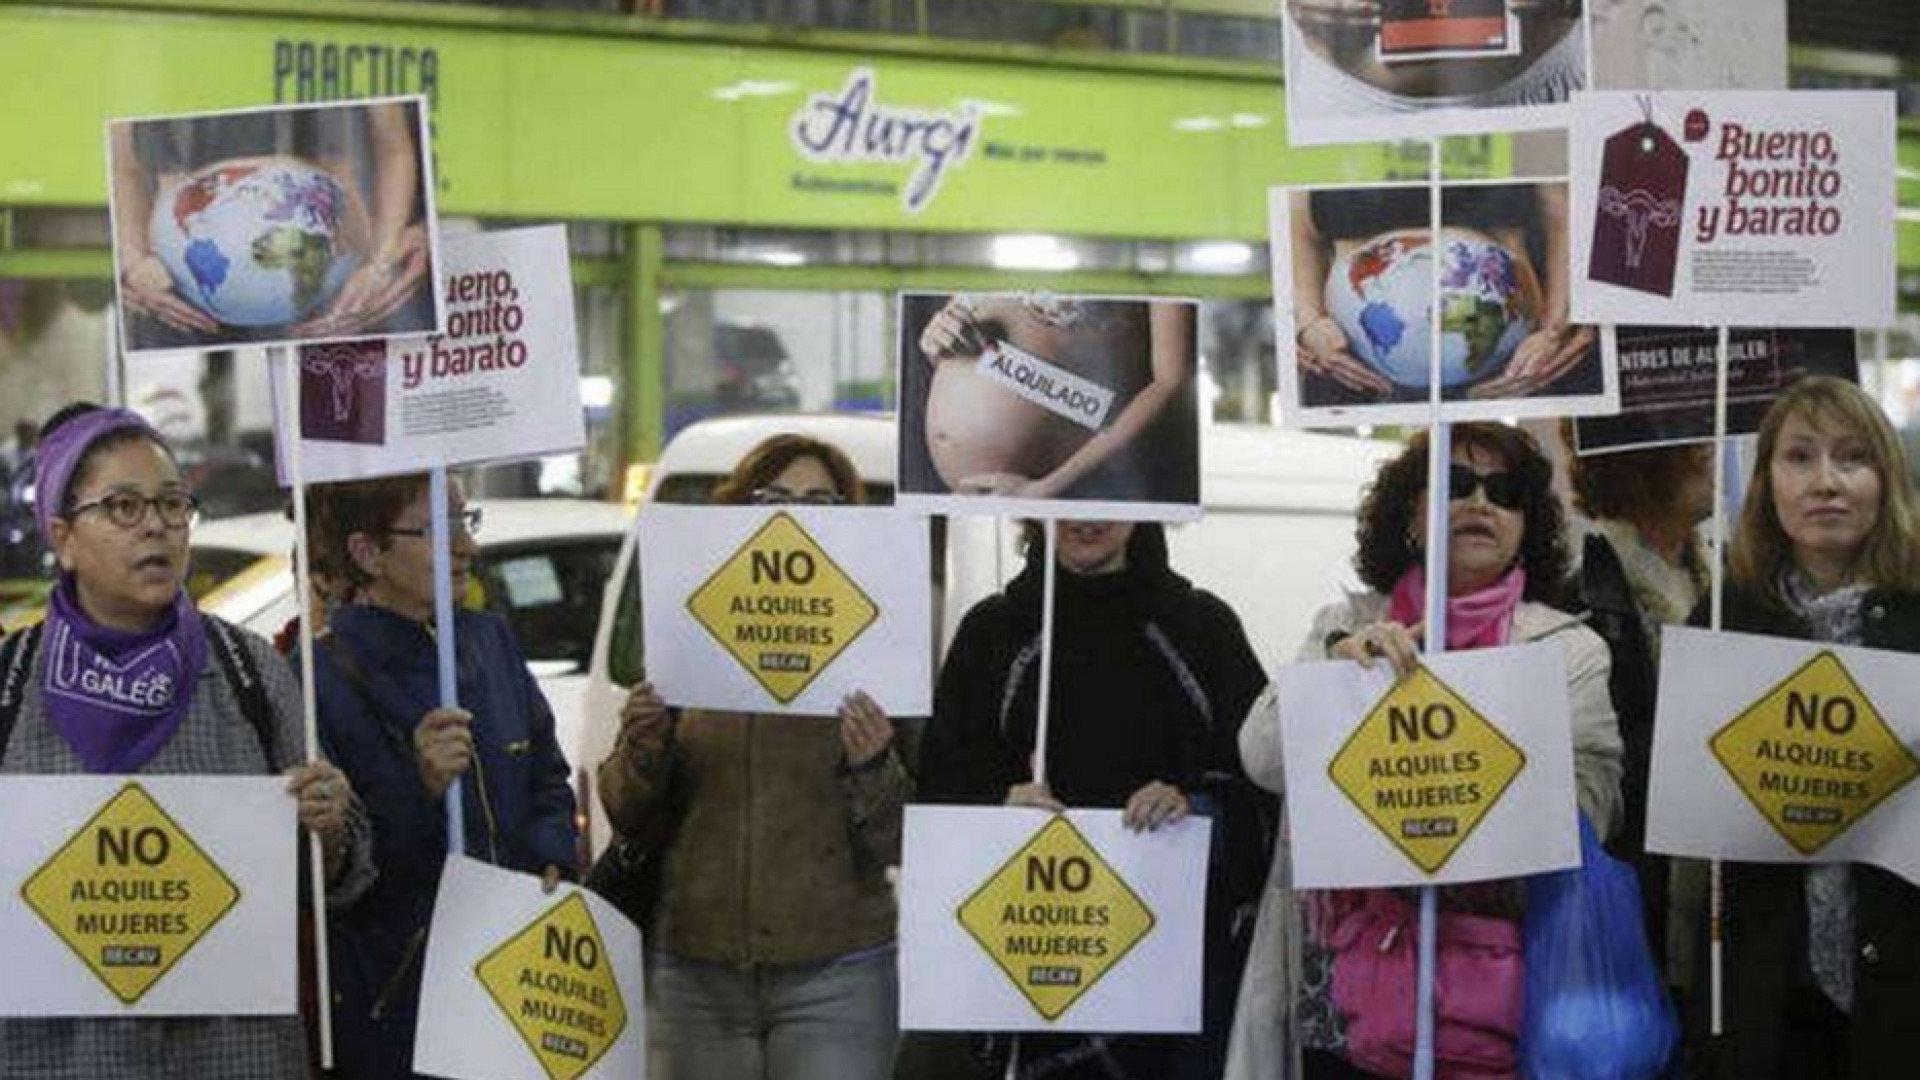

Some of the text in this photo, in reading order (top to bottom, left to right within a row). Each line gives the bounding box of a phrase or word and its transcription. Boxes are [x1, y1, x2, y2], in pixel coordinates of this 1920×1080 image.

[797, 75, 977, 207] Aurgi
[1715, 123, 1838, 168] Bueno,
[1724, 162, 1841, 197] bonito
[1696, 199, 1841, 242] y barato
[446, 302, 523, 339] onito
[403, 336, 527, 389] y barato
[990, 355, 1100, 415] ALQUILADO
[752, 549, 816, 585] NO
[730, 596, 834, 618] ALQUILES
[736, 625, 833, 645] MUJERES
[1388, 702, 1456, 743] NO
[1785, 690, 1857, 735] NO
[1369, 751, 1481, 778] ALQUILES
[1755, 739, 1873, 772] ALQUILES
[1376, 782, 1480, 809] MUJERES
[1760, 771, 1870, 799] MUJERES
[97, 827, 169, 866] NO
[71, 880, 190, 902] ALQUILES
[1026, 856, 1092, 893] NO
[76, 914, 188, 934] MUJERES
[1002, 904, 1109, 926] ALQUILES
[544, 925, 597, 971] NO
[1006, 936, 1108, 956] MUJERES
[518, 969, 607, 1010] ALQUILES
[521, 999, 605, 1038] MUJERES
